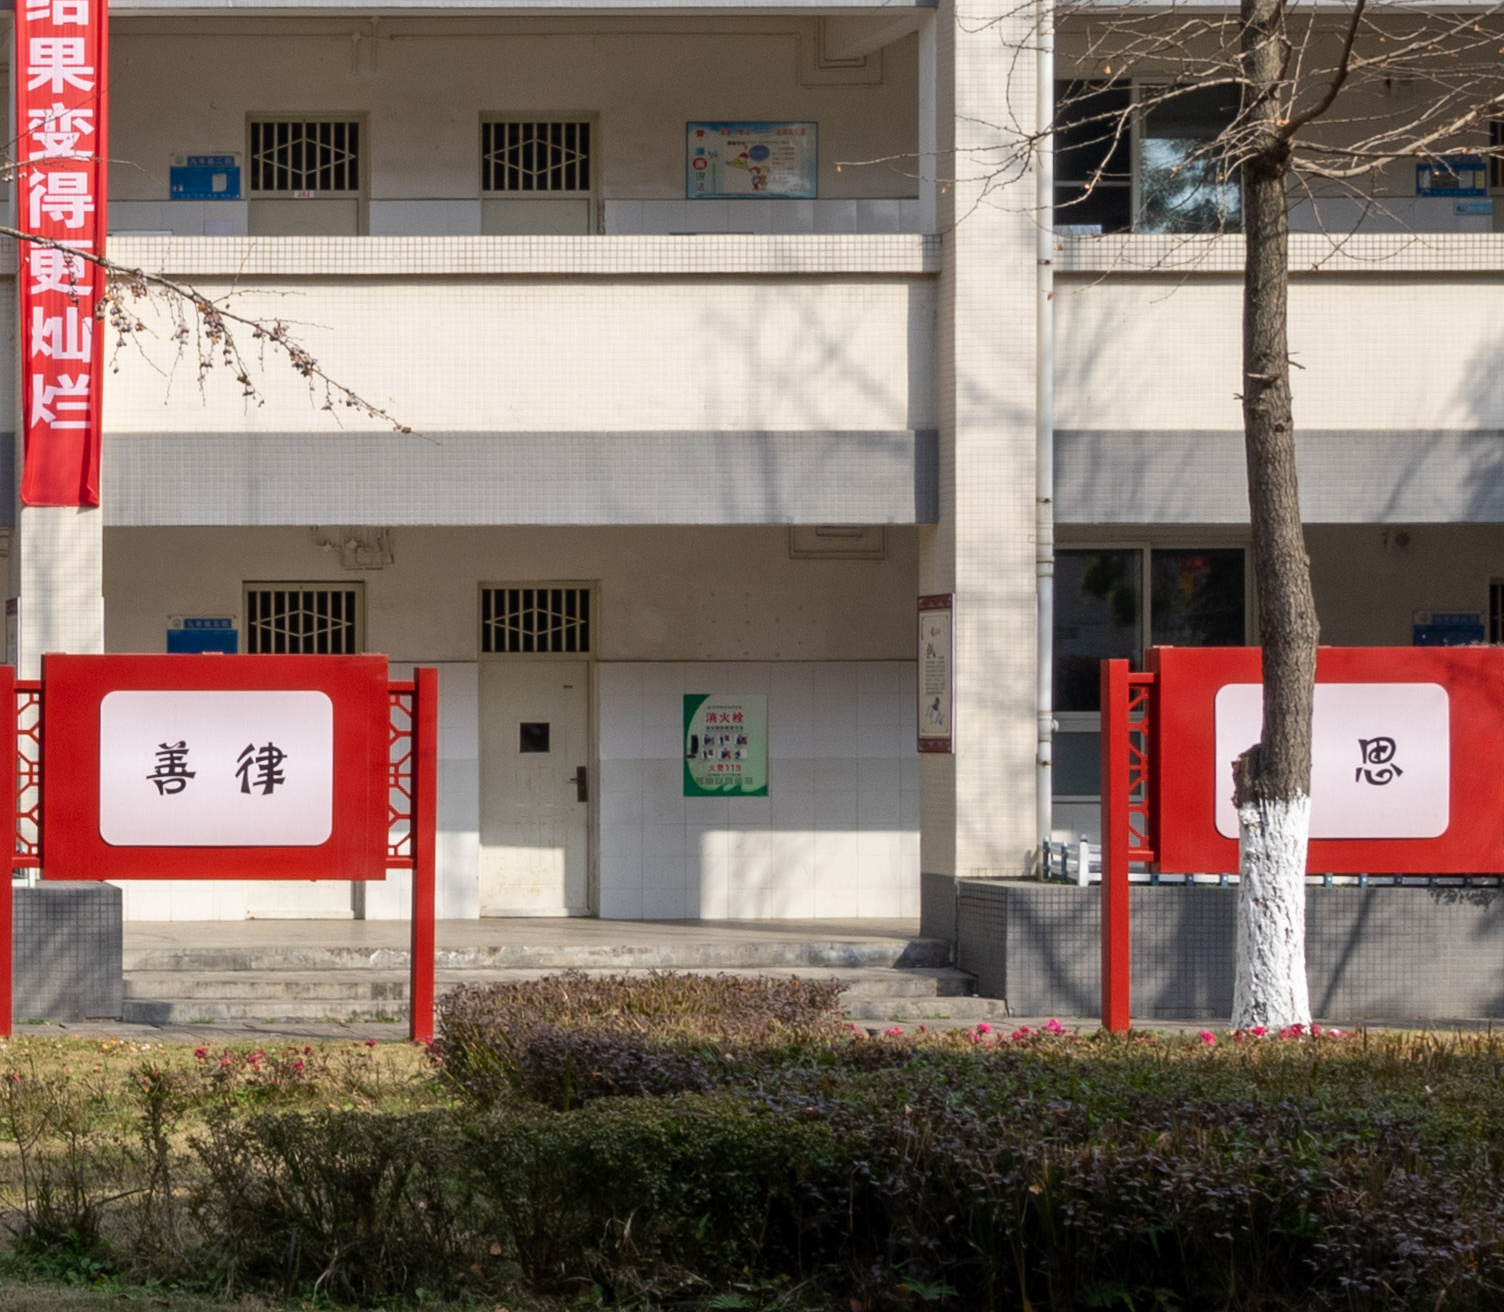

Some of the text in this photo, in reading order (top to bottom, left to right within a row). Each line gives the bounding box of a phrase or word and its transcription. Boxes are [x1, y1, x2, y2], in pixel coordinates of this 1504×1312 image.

[705, 712, 744, 723] 消火栓
[145, 741, 289, 795] 善律
